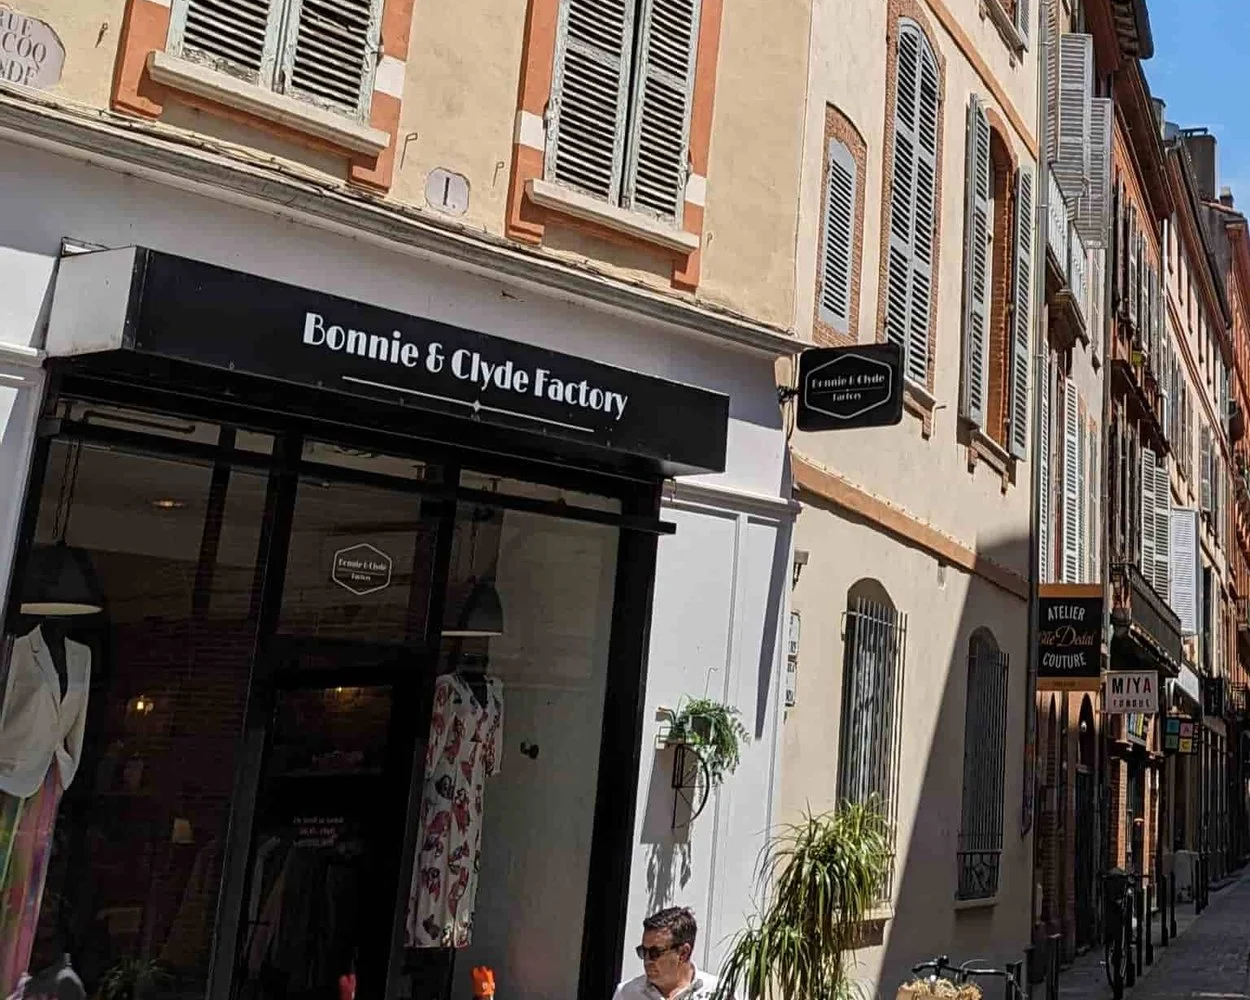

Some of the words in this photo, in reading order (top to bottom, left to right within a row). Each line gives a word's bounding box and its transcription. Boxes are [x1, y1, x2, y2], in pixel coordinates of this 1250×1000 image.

[2, 31, 46, 70] COQ
[303, 312, 418, 367] Bonnie
[426, 342, 445, 373] &
[451, 349, 529, 391] Clyde
[533, 368, 628, 420] Factory
[1048, 605, 1085, 621] ATELIER
[1043, 652, 1086, 670] COUTURE
[1112, 677, 1151, 694] MIYA
